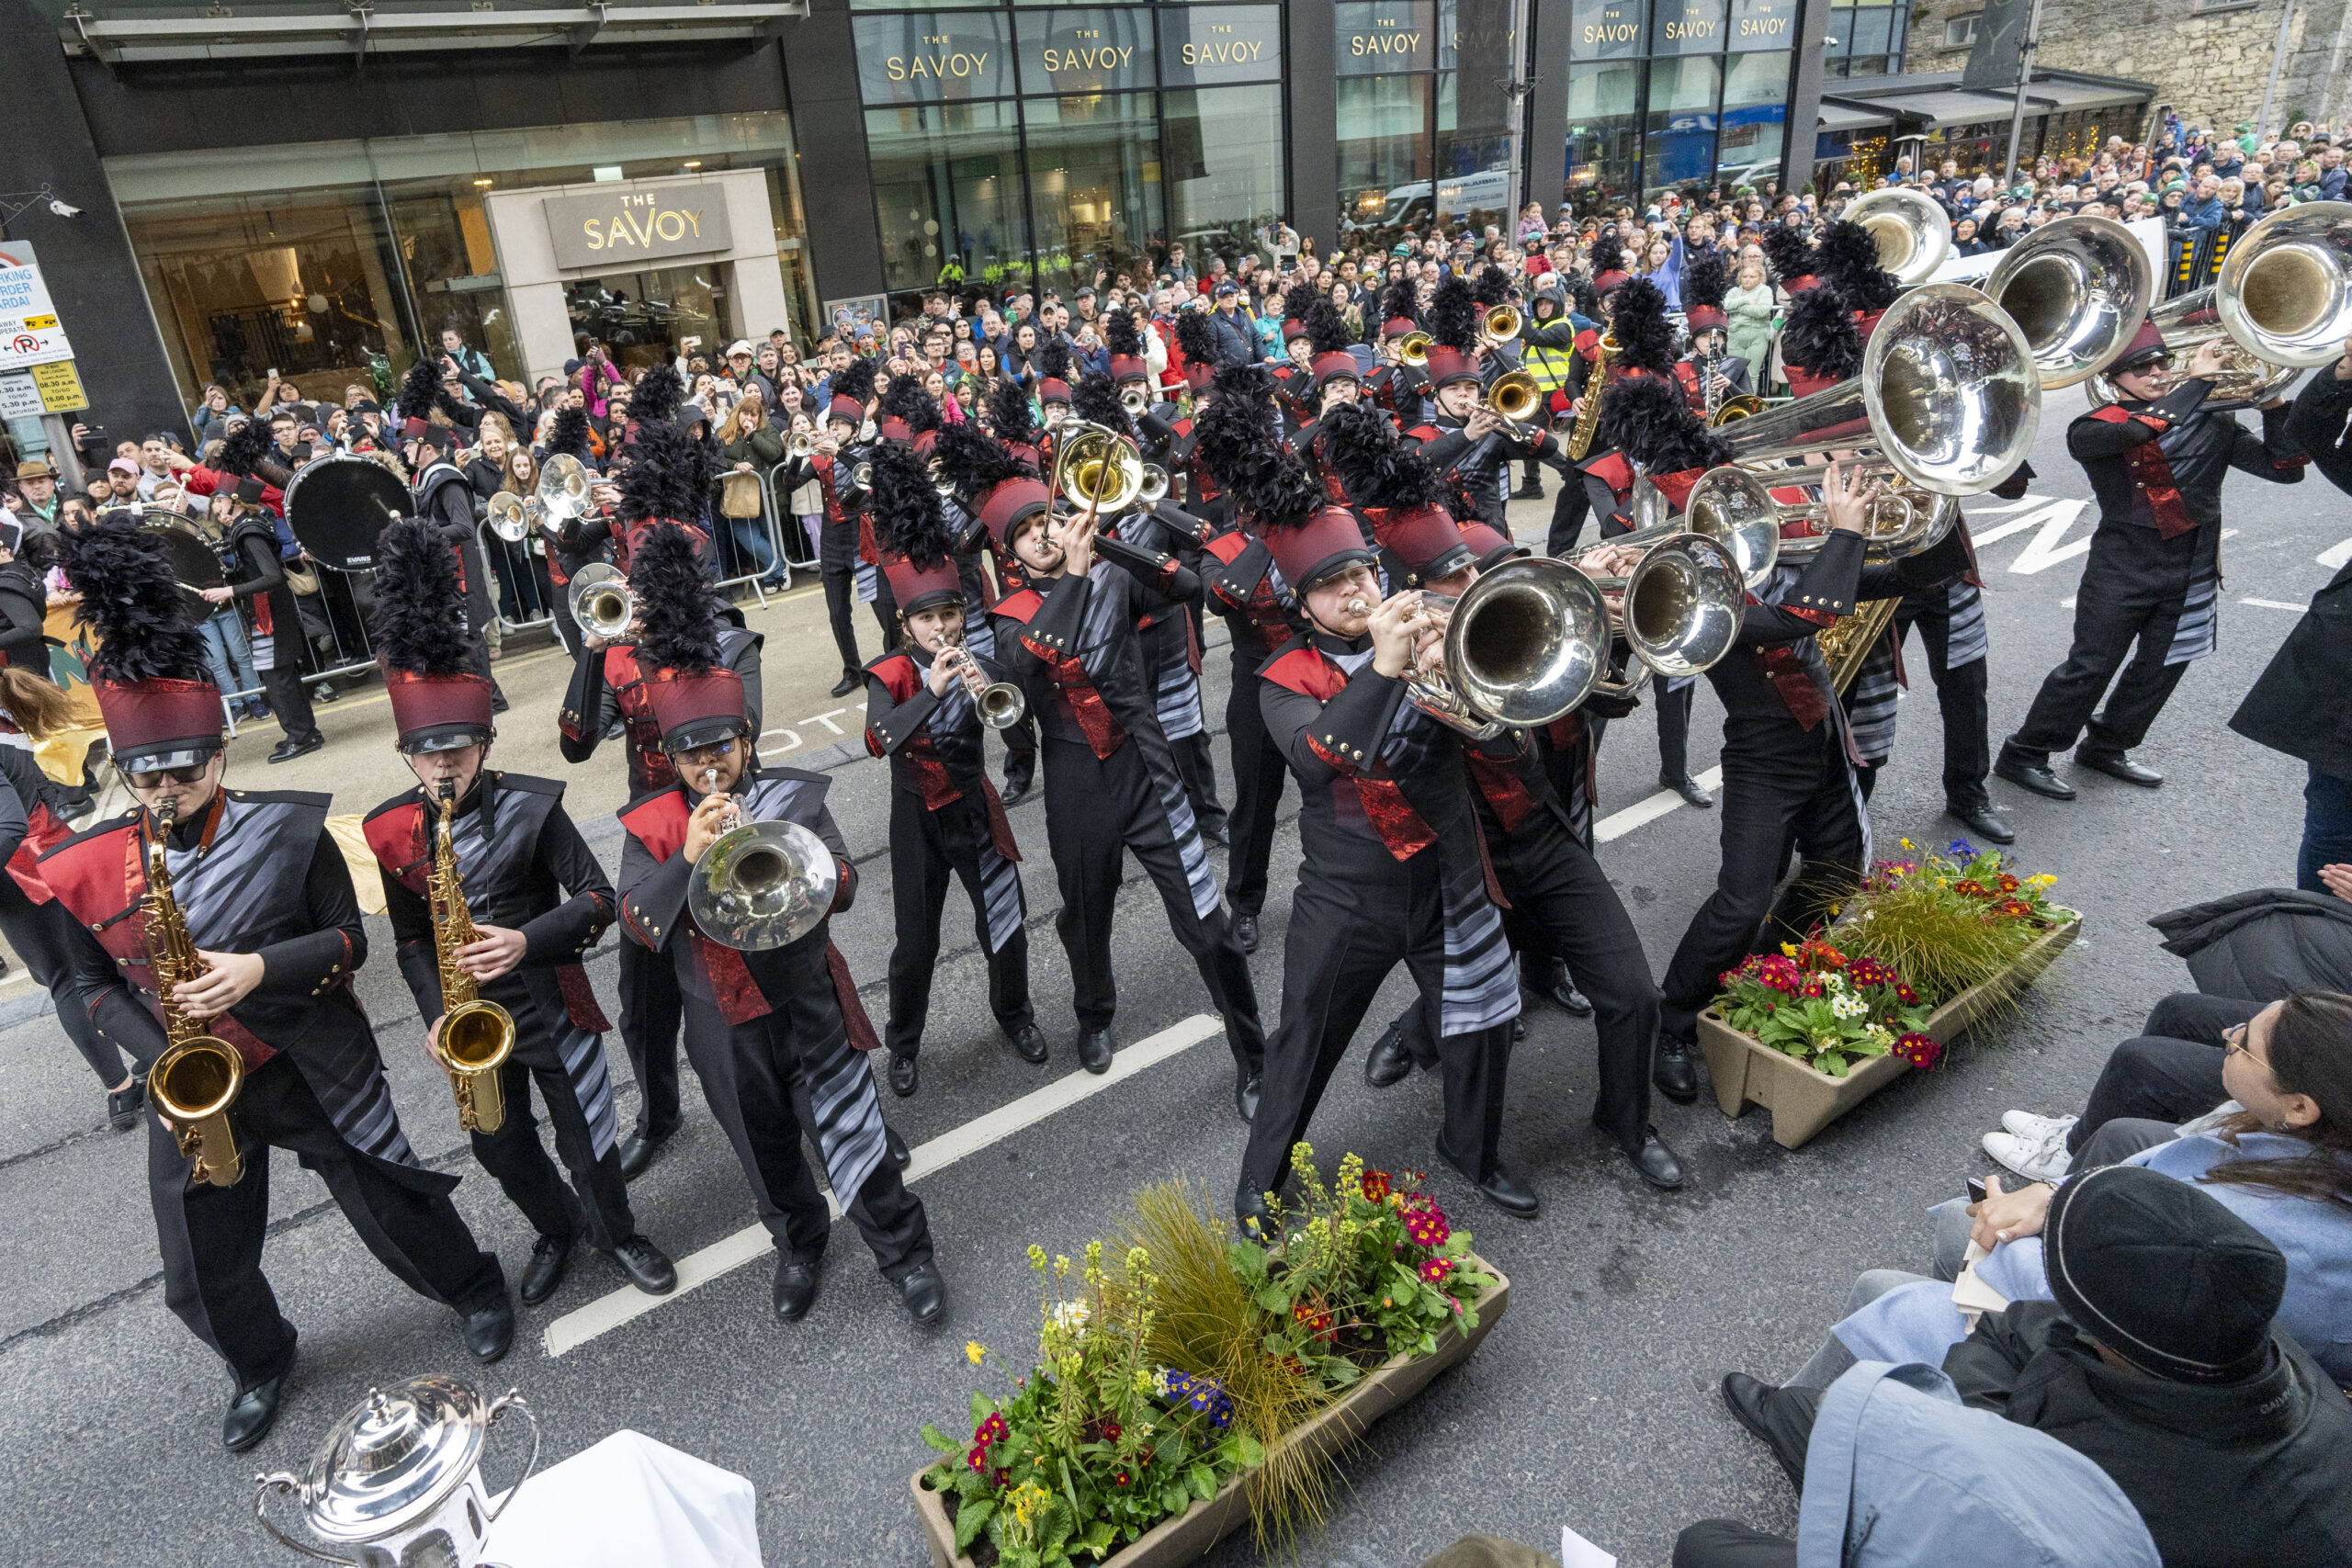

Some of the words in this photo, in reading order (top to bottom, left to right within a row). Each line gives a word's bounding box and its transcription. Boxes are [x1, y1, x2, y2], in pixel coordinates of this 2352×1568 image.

[1211, 25, 1232, 33] THE
[1377, 18, 1396, 27] THE
[1666, 21, 1716, 39] SAVOY
[1739, 17, 1787, 37] SAVOY
[923, 35, 949, 44] THE
[1076, 29, 1099, 39] THE
[1583, 24, 1639, 43] SAVOY
[1182, 40, 1262, 64] SAVOY
[1351, 33, 1420, 56] SAVOY
[887, 52, 988, 81] SAVOY
[1043, 46, 1133, 72] SAVOY
[620, 193, 655, 208] THE
[583, 208, 704, 250] SAVOY
[8, 407, 39, 415] SATURDAY
[346, 555, 371, 563] EVANS
